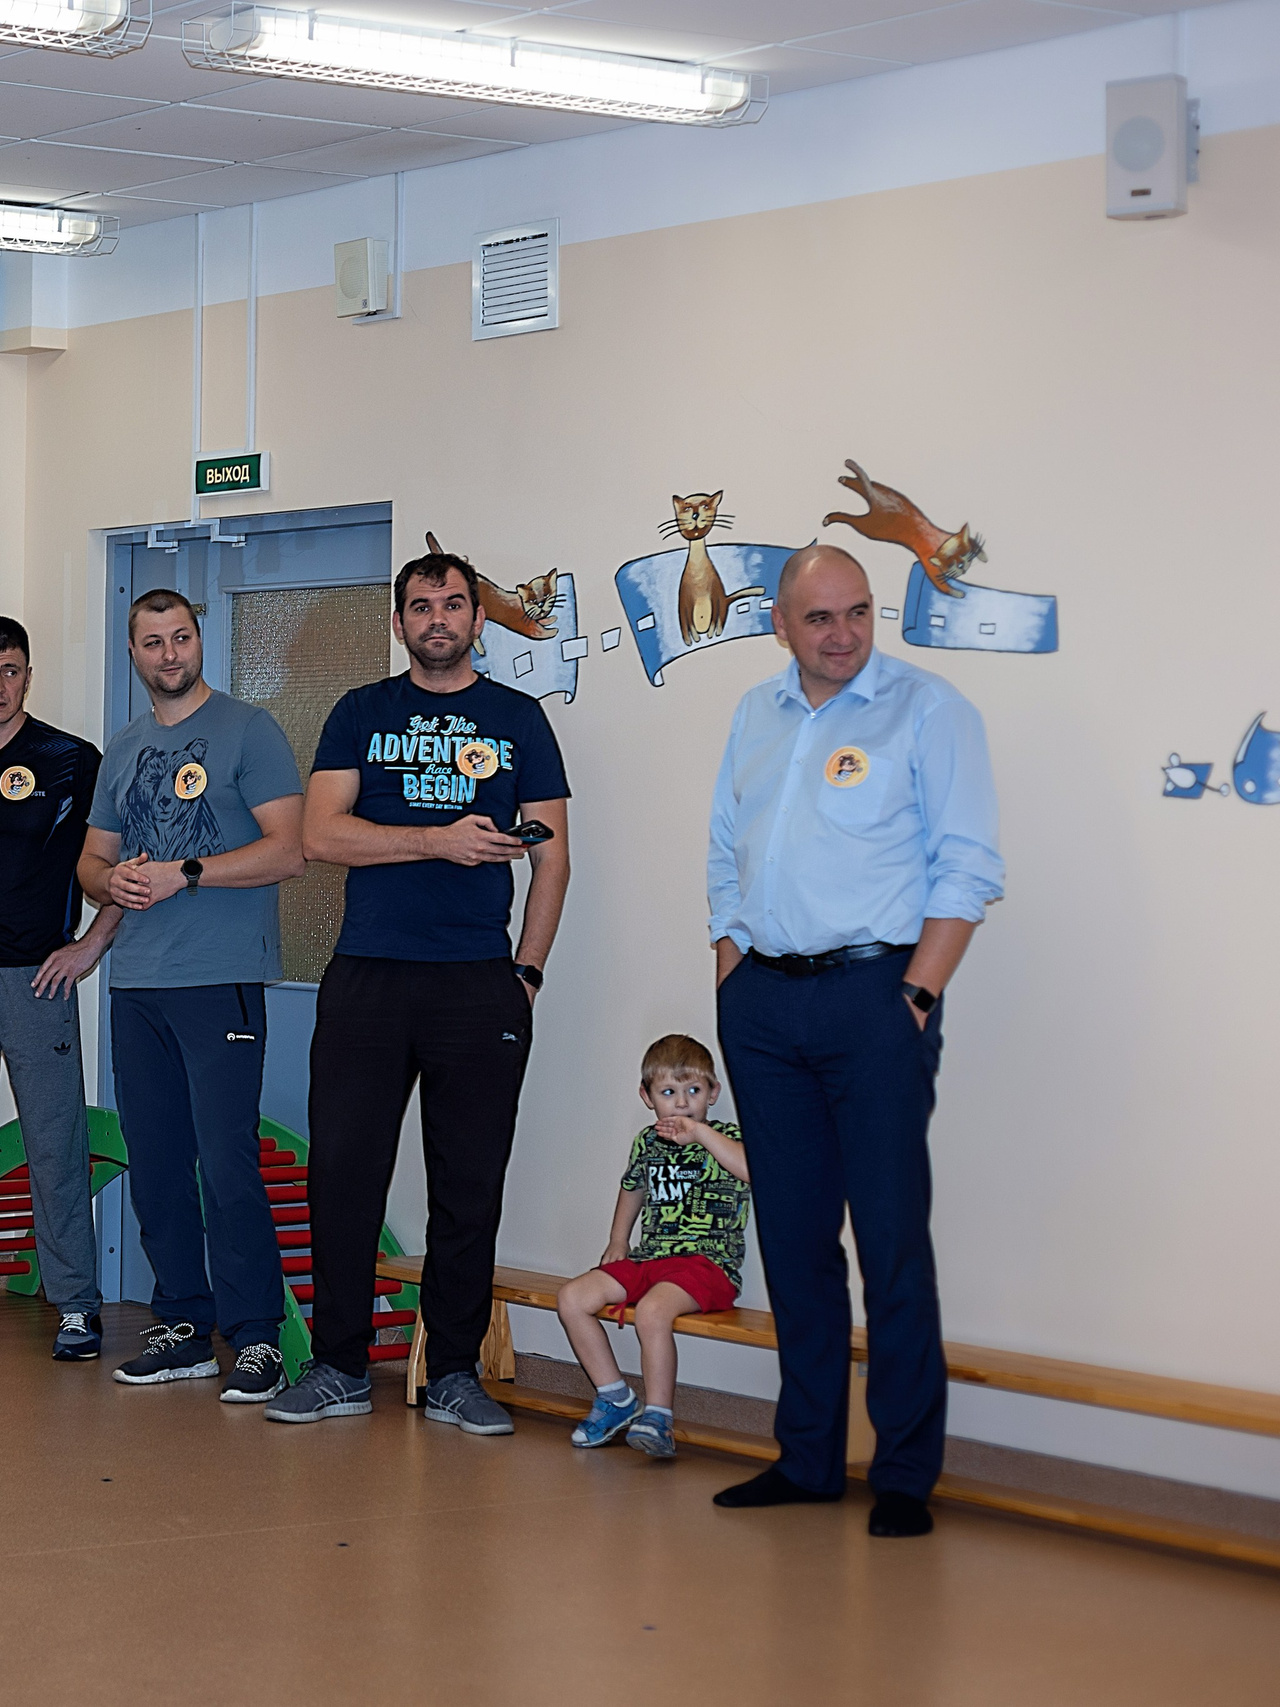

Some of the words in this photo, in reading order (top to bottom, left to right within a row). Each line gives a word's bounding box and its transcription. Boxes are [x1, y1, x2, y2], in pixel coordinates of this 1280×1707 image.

[206, 464, 250, 484] ВЫХОД
[406, 715, 439, 735] Get
[440, 715, 477, 735] The
[425, 763, 452, 774] Race
[402, 773, 477, 803] BEGIN
